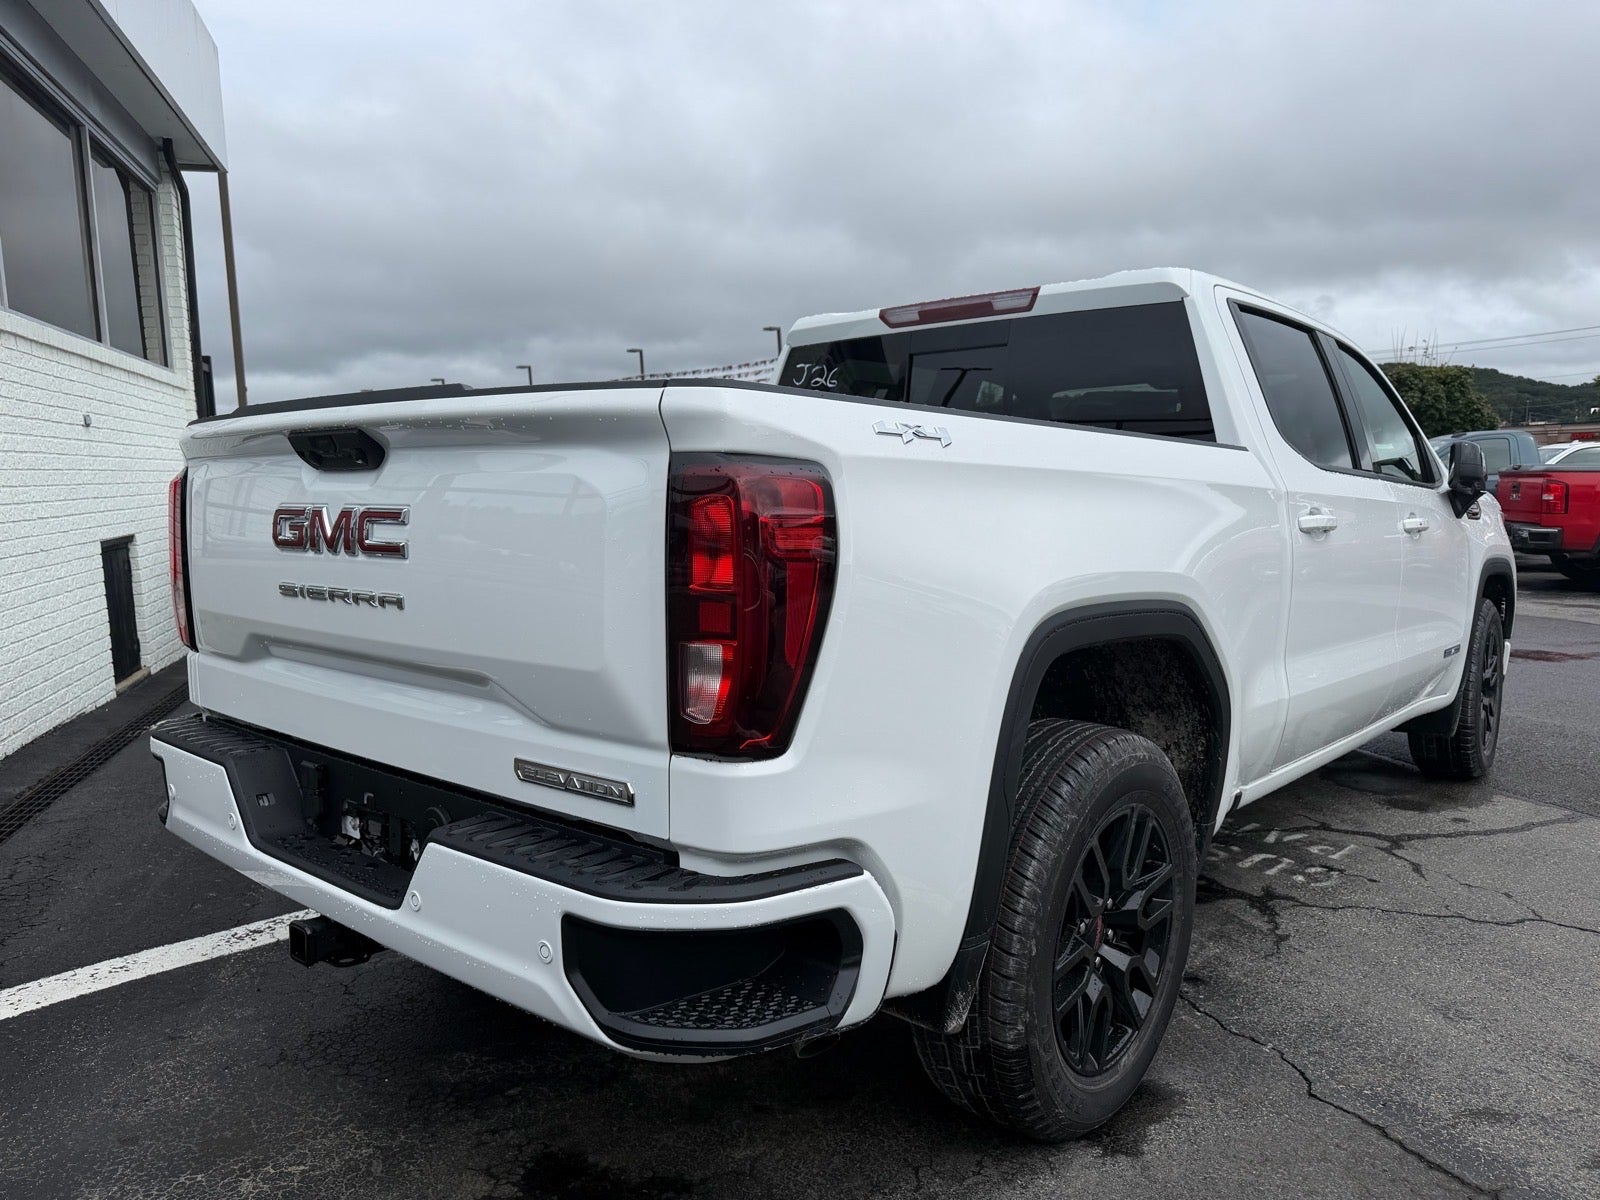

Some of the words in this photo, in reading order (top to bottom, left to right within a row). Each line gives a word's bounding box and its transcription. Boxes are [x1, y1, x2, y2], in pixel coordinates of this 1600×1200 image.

[793, 363, 838, 388] J26
[272, 502, 411, 559] GMC
[278, 581, 405, 610] SIERRA
[523, 764, 624, 800] ELEVATION
